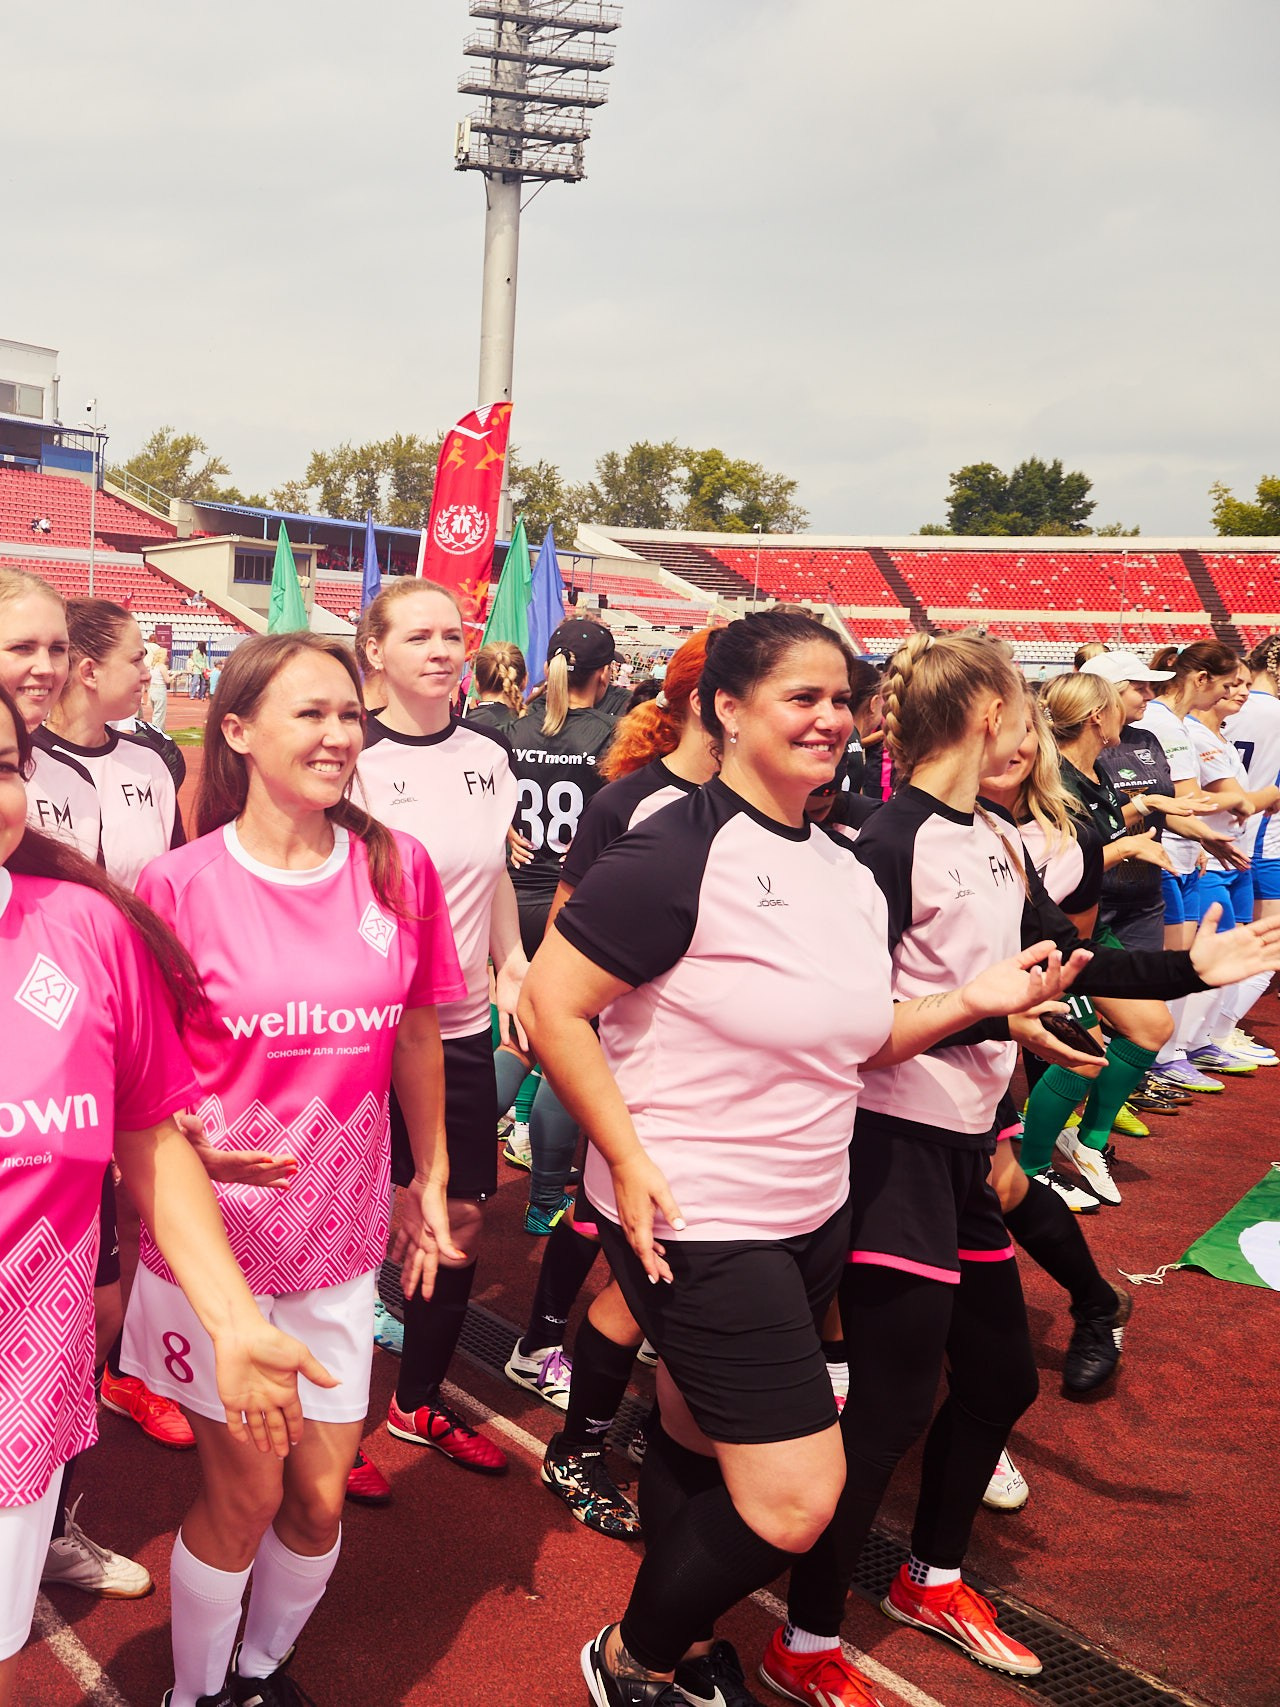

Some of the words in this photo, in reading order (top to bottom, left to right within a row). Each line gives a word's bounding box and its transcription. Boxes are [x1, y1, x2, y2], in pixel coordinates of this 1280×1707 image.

[121, 780, 154, 810] FM
[464, 768, 495, 798] FM
[36, 798, 73, 831] FM
[517, 778, 584, 853] 38
[988, 855, 1015, 888] FM
[221, 1000, 403, 1041] welltown
[1067, 994, 1093, 1019] 11
[266, 1047, 311, 1059] основан
[312, 1047, 334, 1056] для
[336, 1043, 370, 1055] людей
[1, 1151, 53, 1168] людей
[162, 1331, 194, 1383] 8
